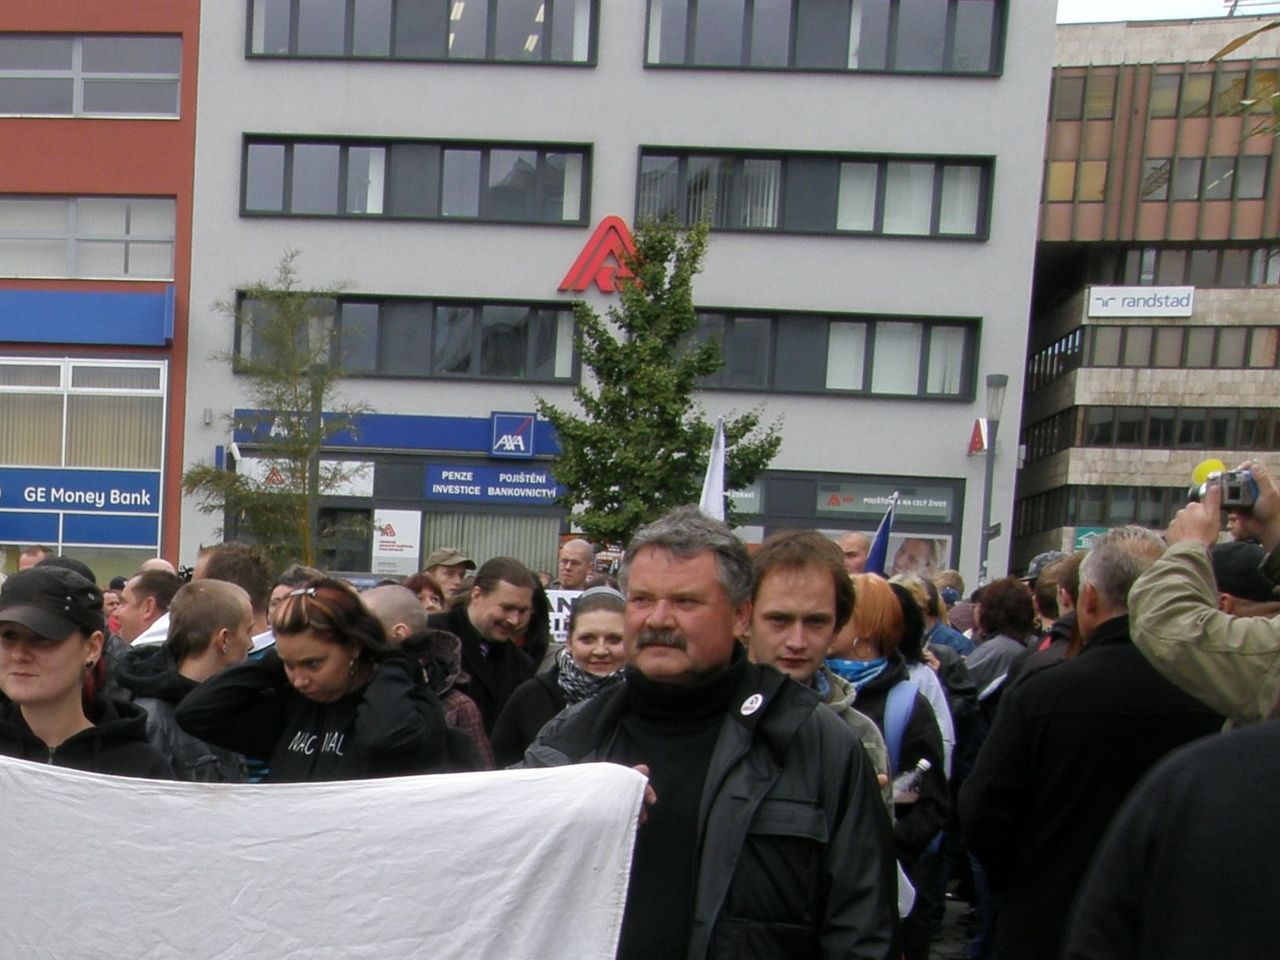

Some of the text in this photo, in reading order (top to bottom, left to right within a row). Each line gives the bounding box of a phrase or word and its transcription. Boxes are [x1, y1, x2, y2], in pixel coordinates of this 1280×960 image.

[1121, 293, 1191, 308] randstad
[493, 434, 526, 451] AXA
[441, 471, 547, 484] PENZE POJIŠTĚNÍ
[23, 487, 151, 507] GE Money Bank
[432, 484, 557, 498] INVESTICE BANKOVNICTVÍ
